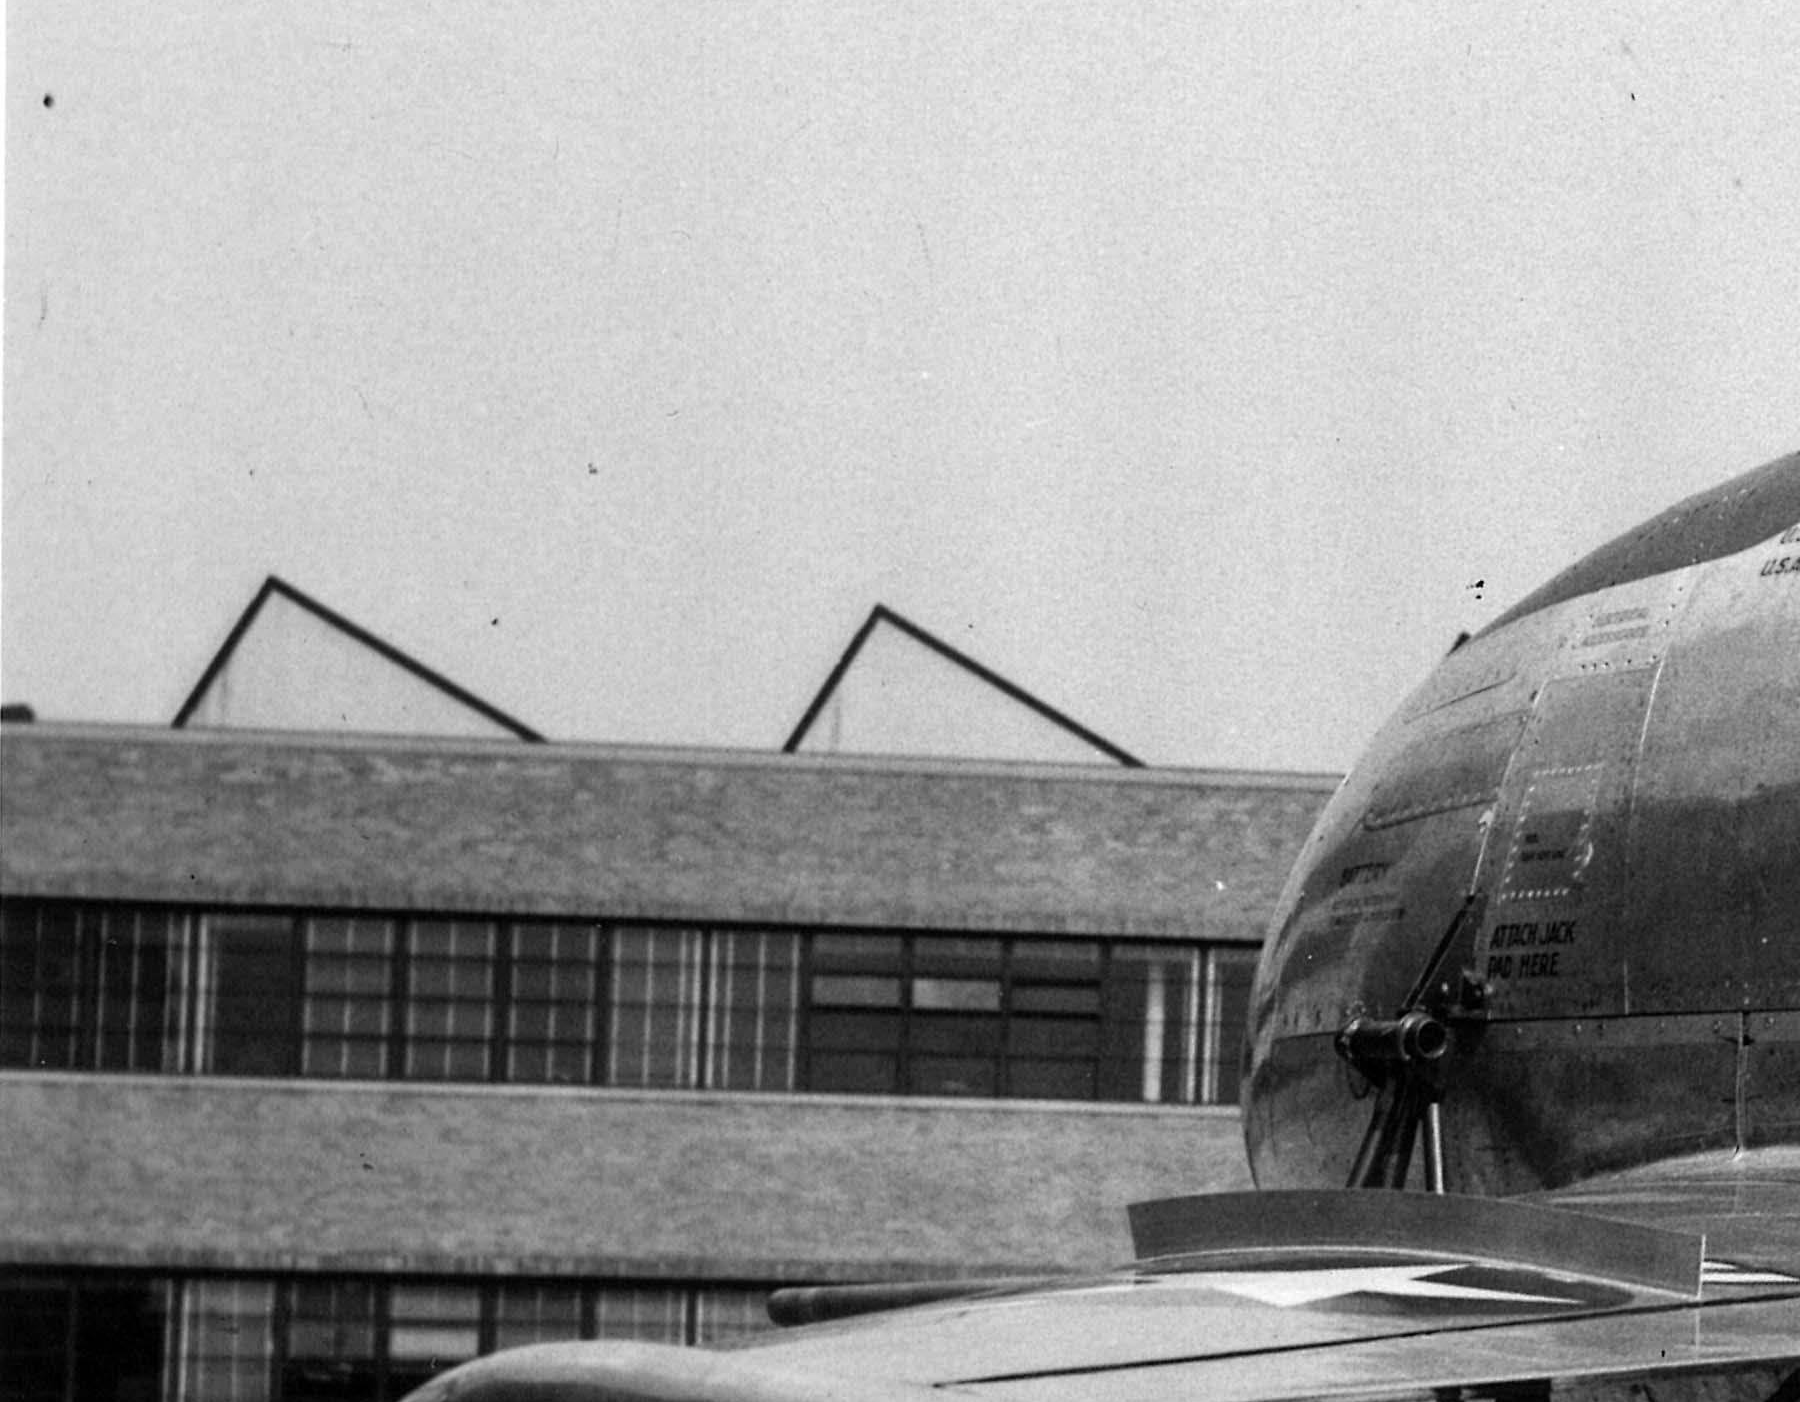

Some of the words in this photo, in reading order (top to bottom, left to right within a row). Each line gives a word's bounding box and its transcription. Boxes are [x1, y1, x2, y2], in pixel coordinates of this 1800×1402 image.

[1489, 921, 1538, 950] ATTACH
[1539, 920, 1577, 946] JACK
[1487, 954, 1513, 981] PAD
[1518, 951, 1561, 980] HERE
